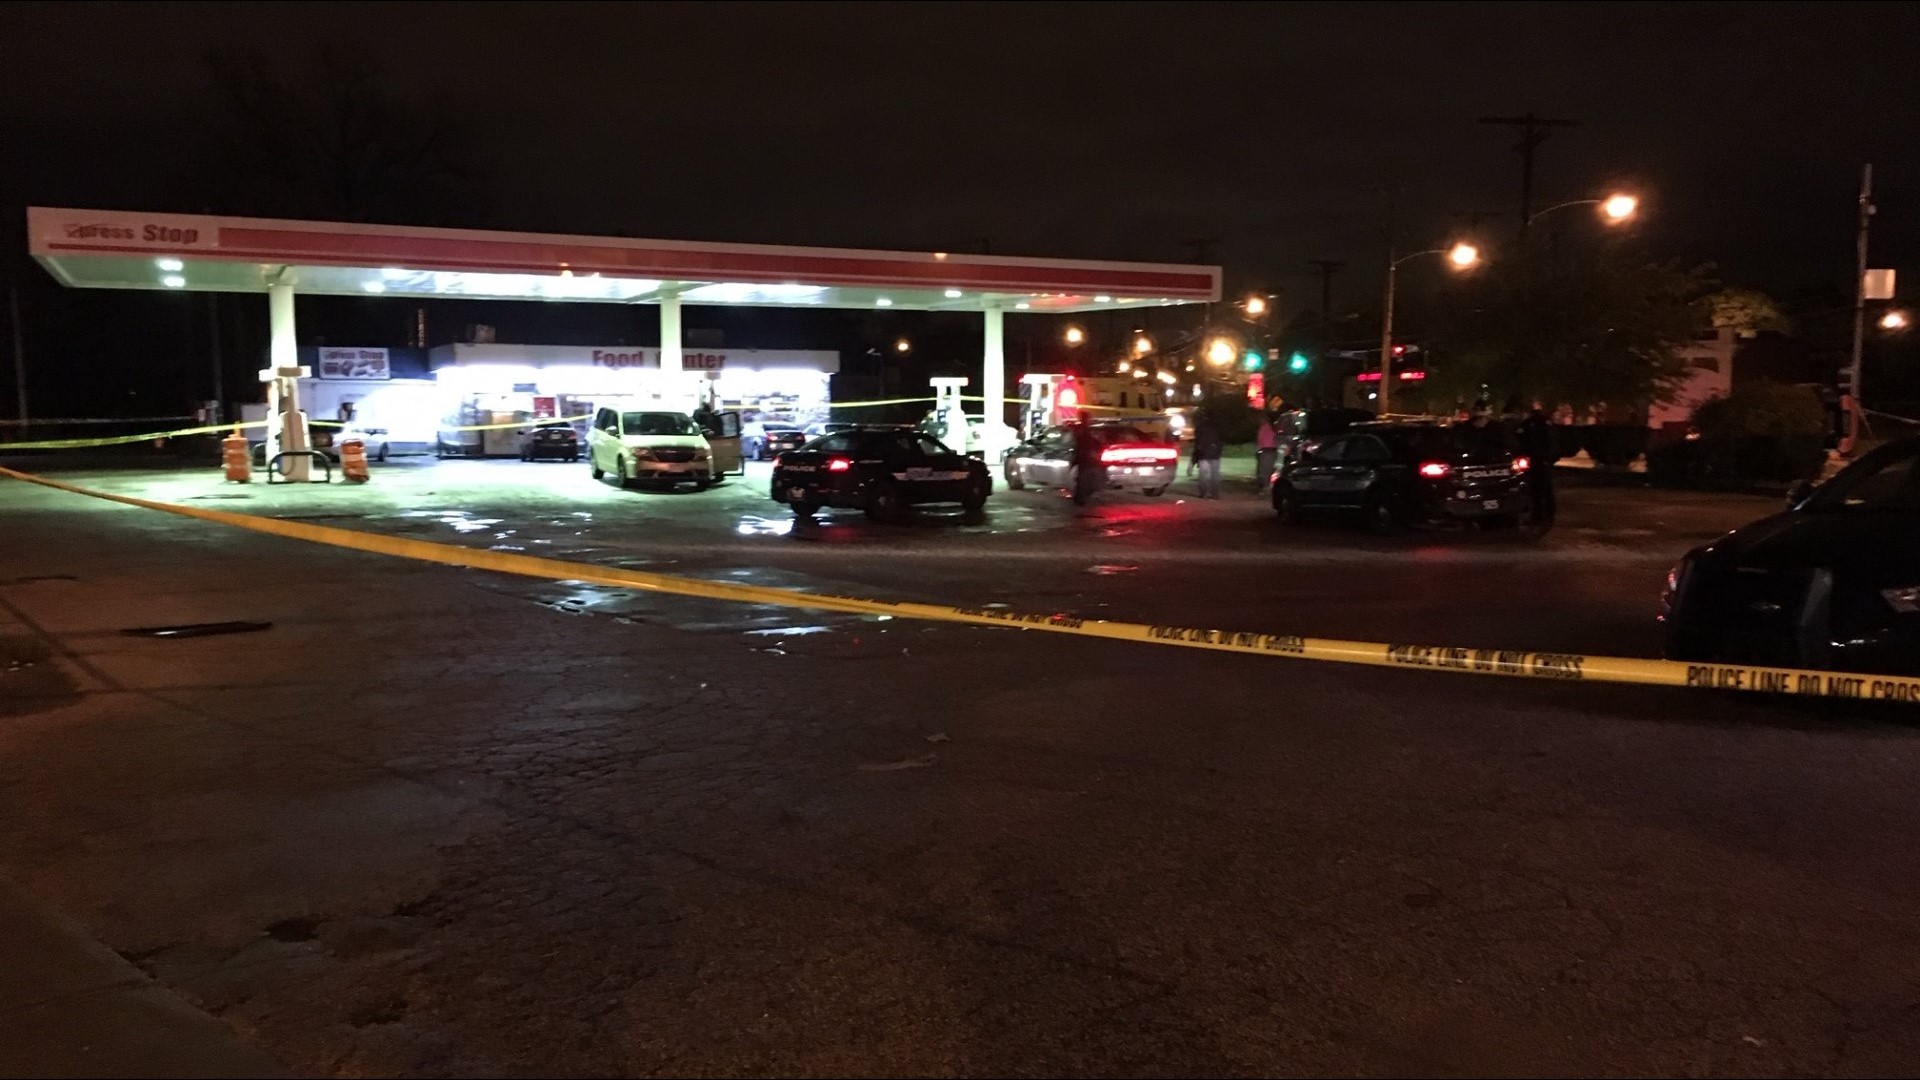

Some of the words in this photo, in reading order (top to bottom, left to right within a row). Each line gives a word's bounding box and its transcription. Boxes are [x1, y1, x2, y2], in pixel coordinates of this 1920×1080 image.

[142, 224, 198, 244] Stop
[592, 350, 644, 367] Food
[656, 351, 726, 369] nter
[1463, 469, 1509, 478] POLICE
[1386, 643, 1433, 665] POLICE
[1437, 646, 1470, 669] LINE
[1474, 649, 1494, 672] DO
[1498, 651, 1525, 676] NOT
[1532, 653, 1585, 681] CROSS
[1686, 665, 1746, 689] POLICE
[1751, 669, 1791, 692] LINE
[1797, 673, 1822, 696] DO
[1826, 676, 1867, 698] NOT
